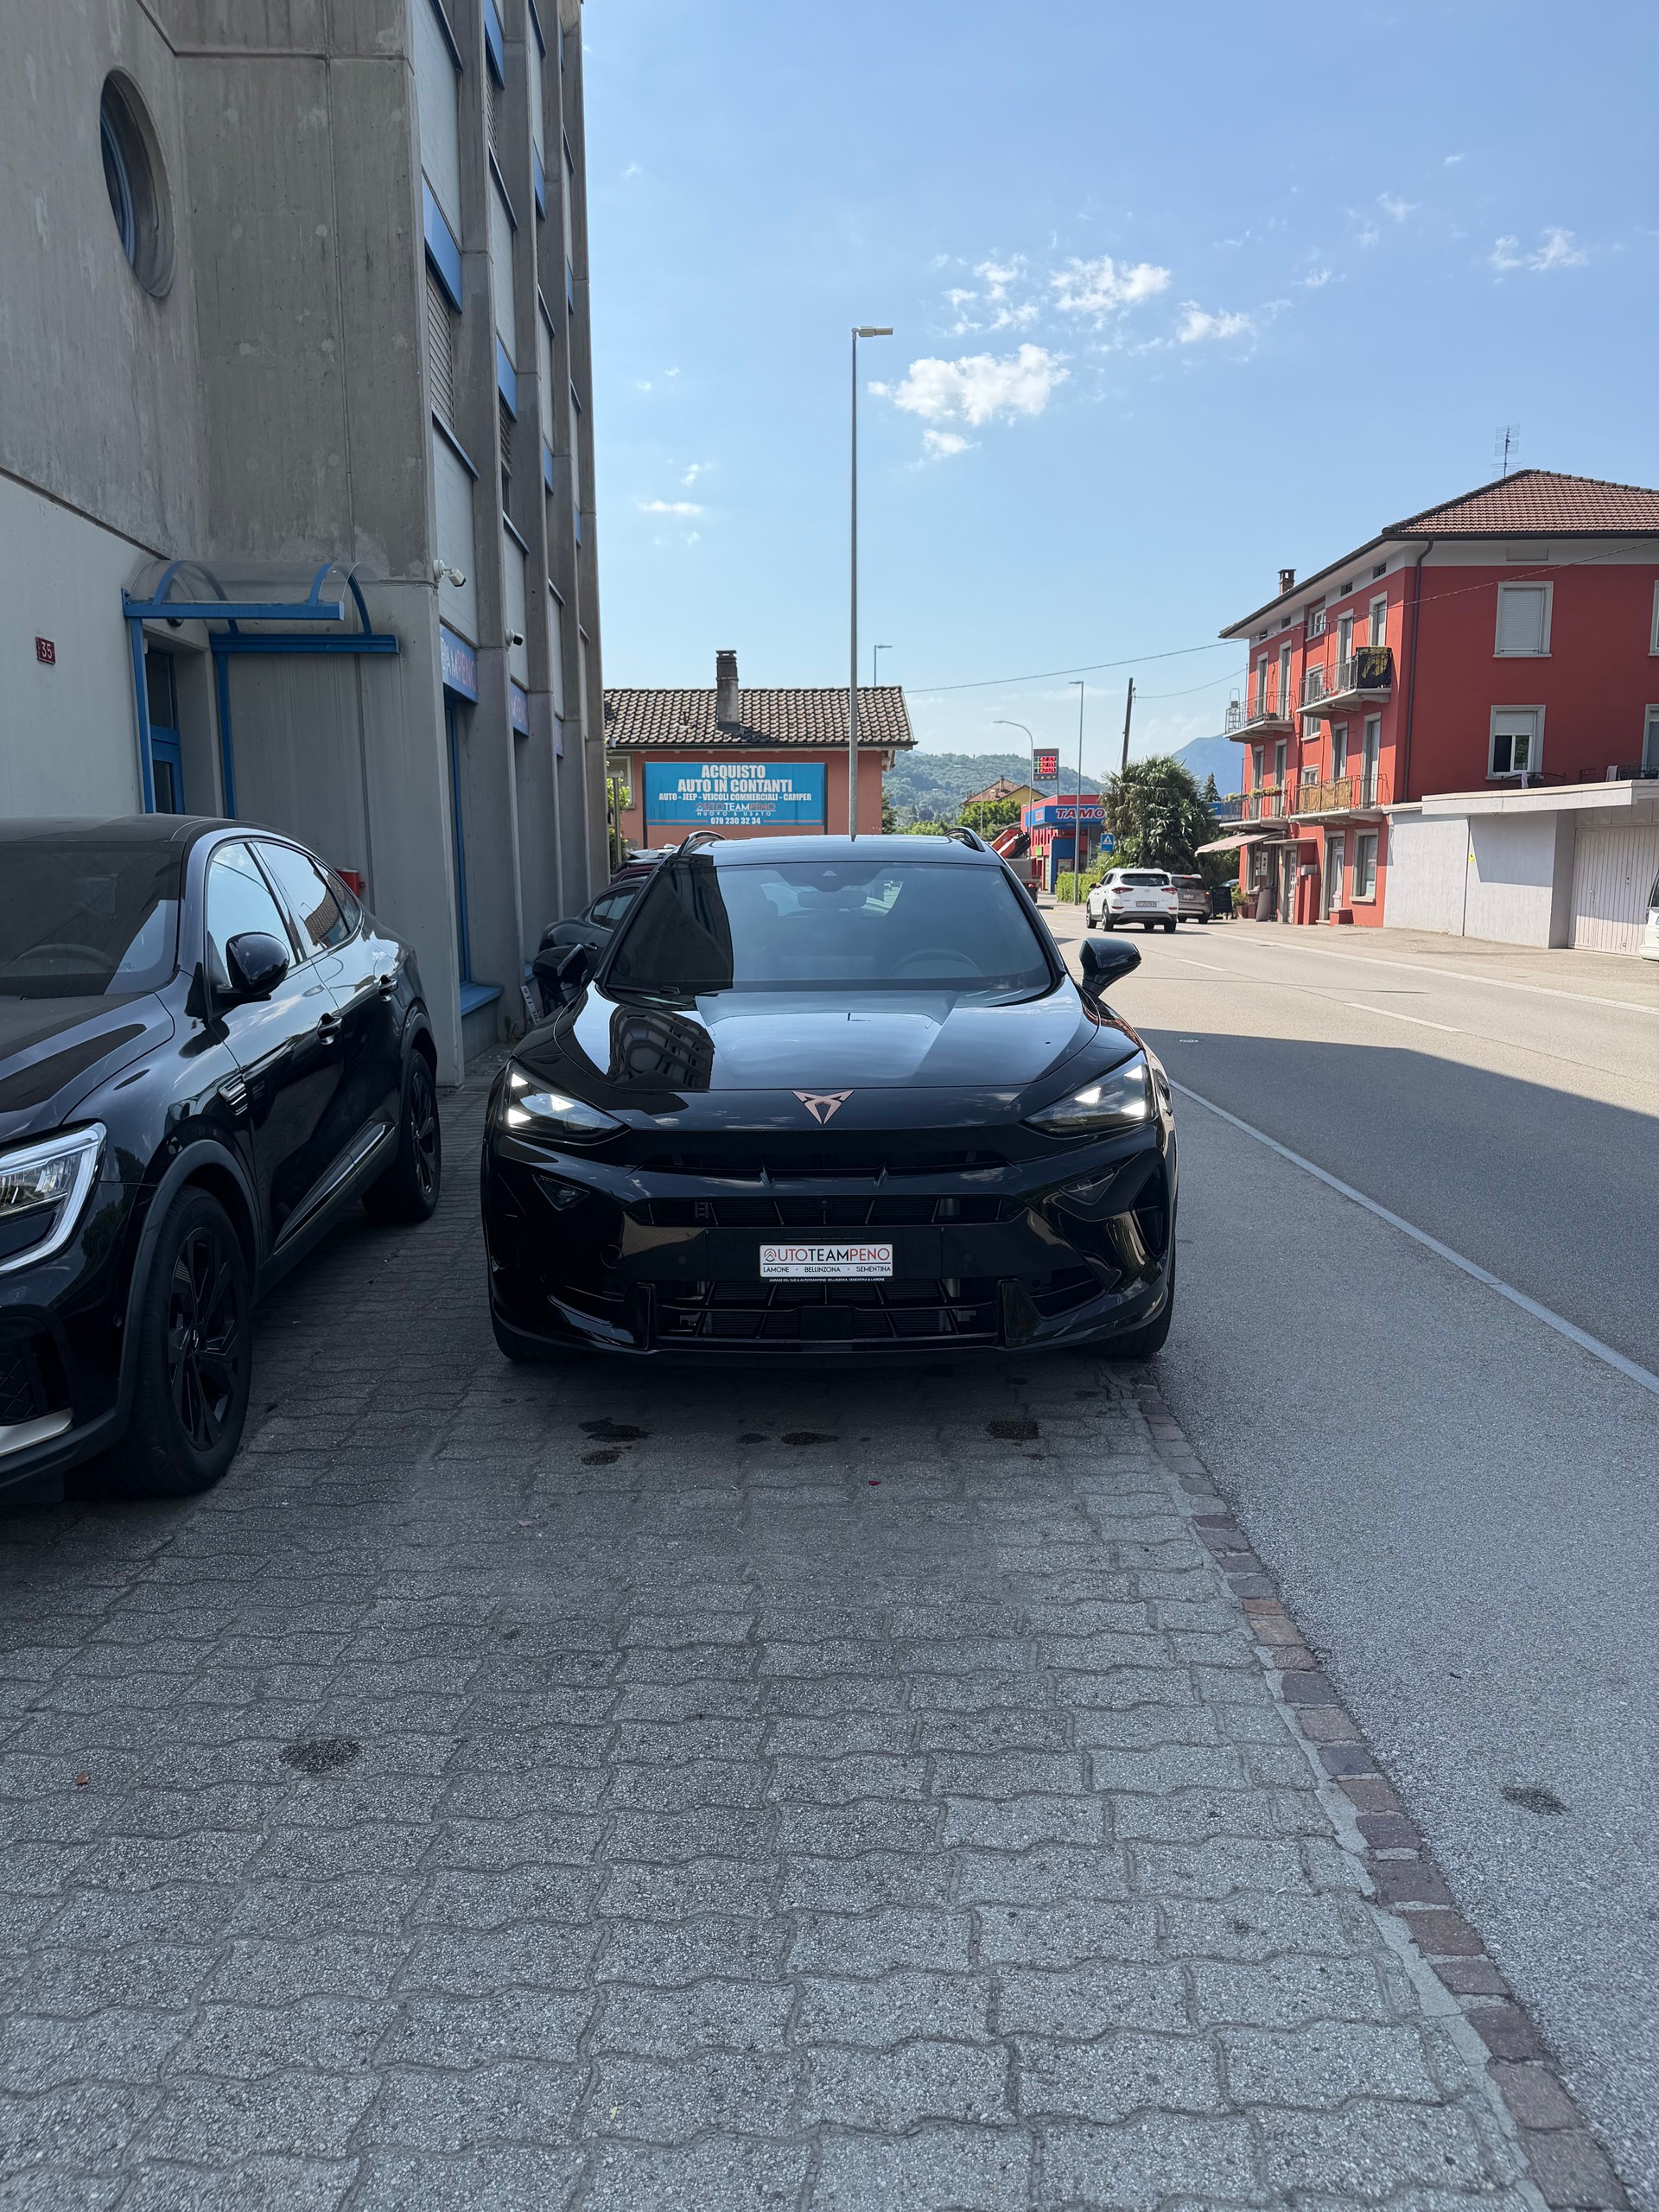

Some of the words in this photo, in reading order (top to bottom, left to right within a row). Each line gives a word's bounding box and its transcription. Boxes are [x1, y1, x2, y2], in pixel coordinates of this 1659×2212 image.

[41, 641, 53, 659] 35
[702, 765, 766, 779] ACQUISTO
[677, 779, 711, 792] AUTO
[714, 779, 728, 792] IN
[730, 779, 792, 792] CONTANTI
[710, 817, 724, 825] 079
[725, 817, 740, 825] 230
[741, 817, 750, 825] 32
[751, 817, 760, 825] 34
